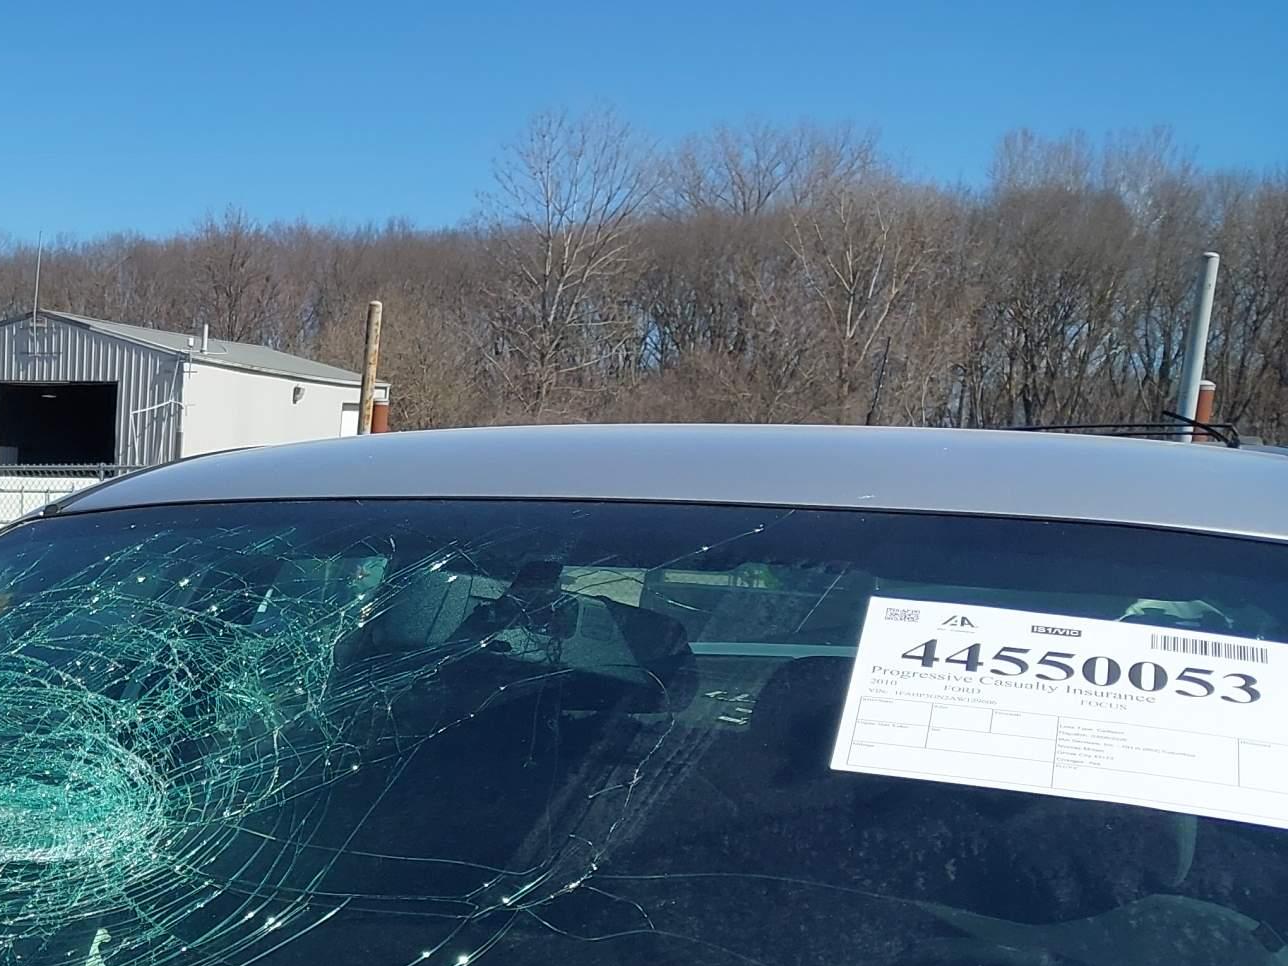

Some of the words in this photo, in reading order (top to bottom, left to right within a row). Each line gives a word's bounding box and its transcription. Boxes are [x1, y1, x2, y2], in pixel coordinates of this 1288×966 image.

[871, 665, 974, 684] Progressive
[979, 676, 1059, 694] Casualty
[1066, 685, 1157, 704] Insurance
[901, 638, 1262, 705] 44550053
[870, 677, 898, 687] 2010
[943, 685, 982, 695] FORD
[1079, 699, 1128, 711] FOCUS
